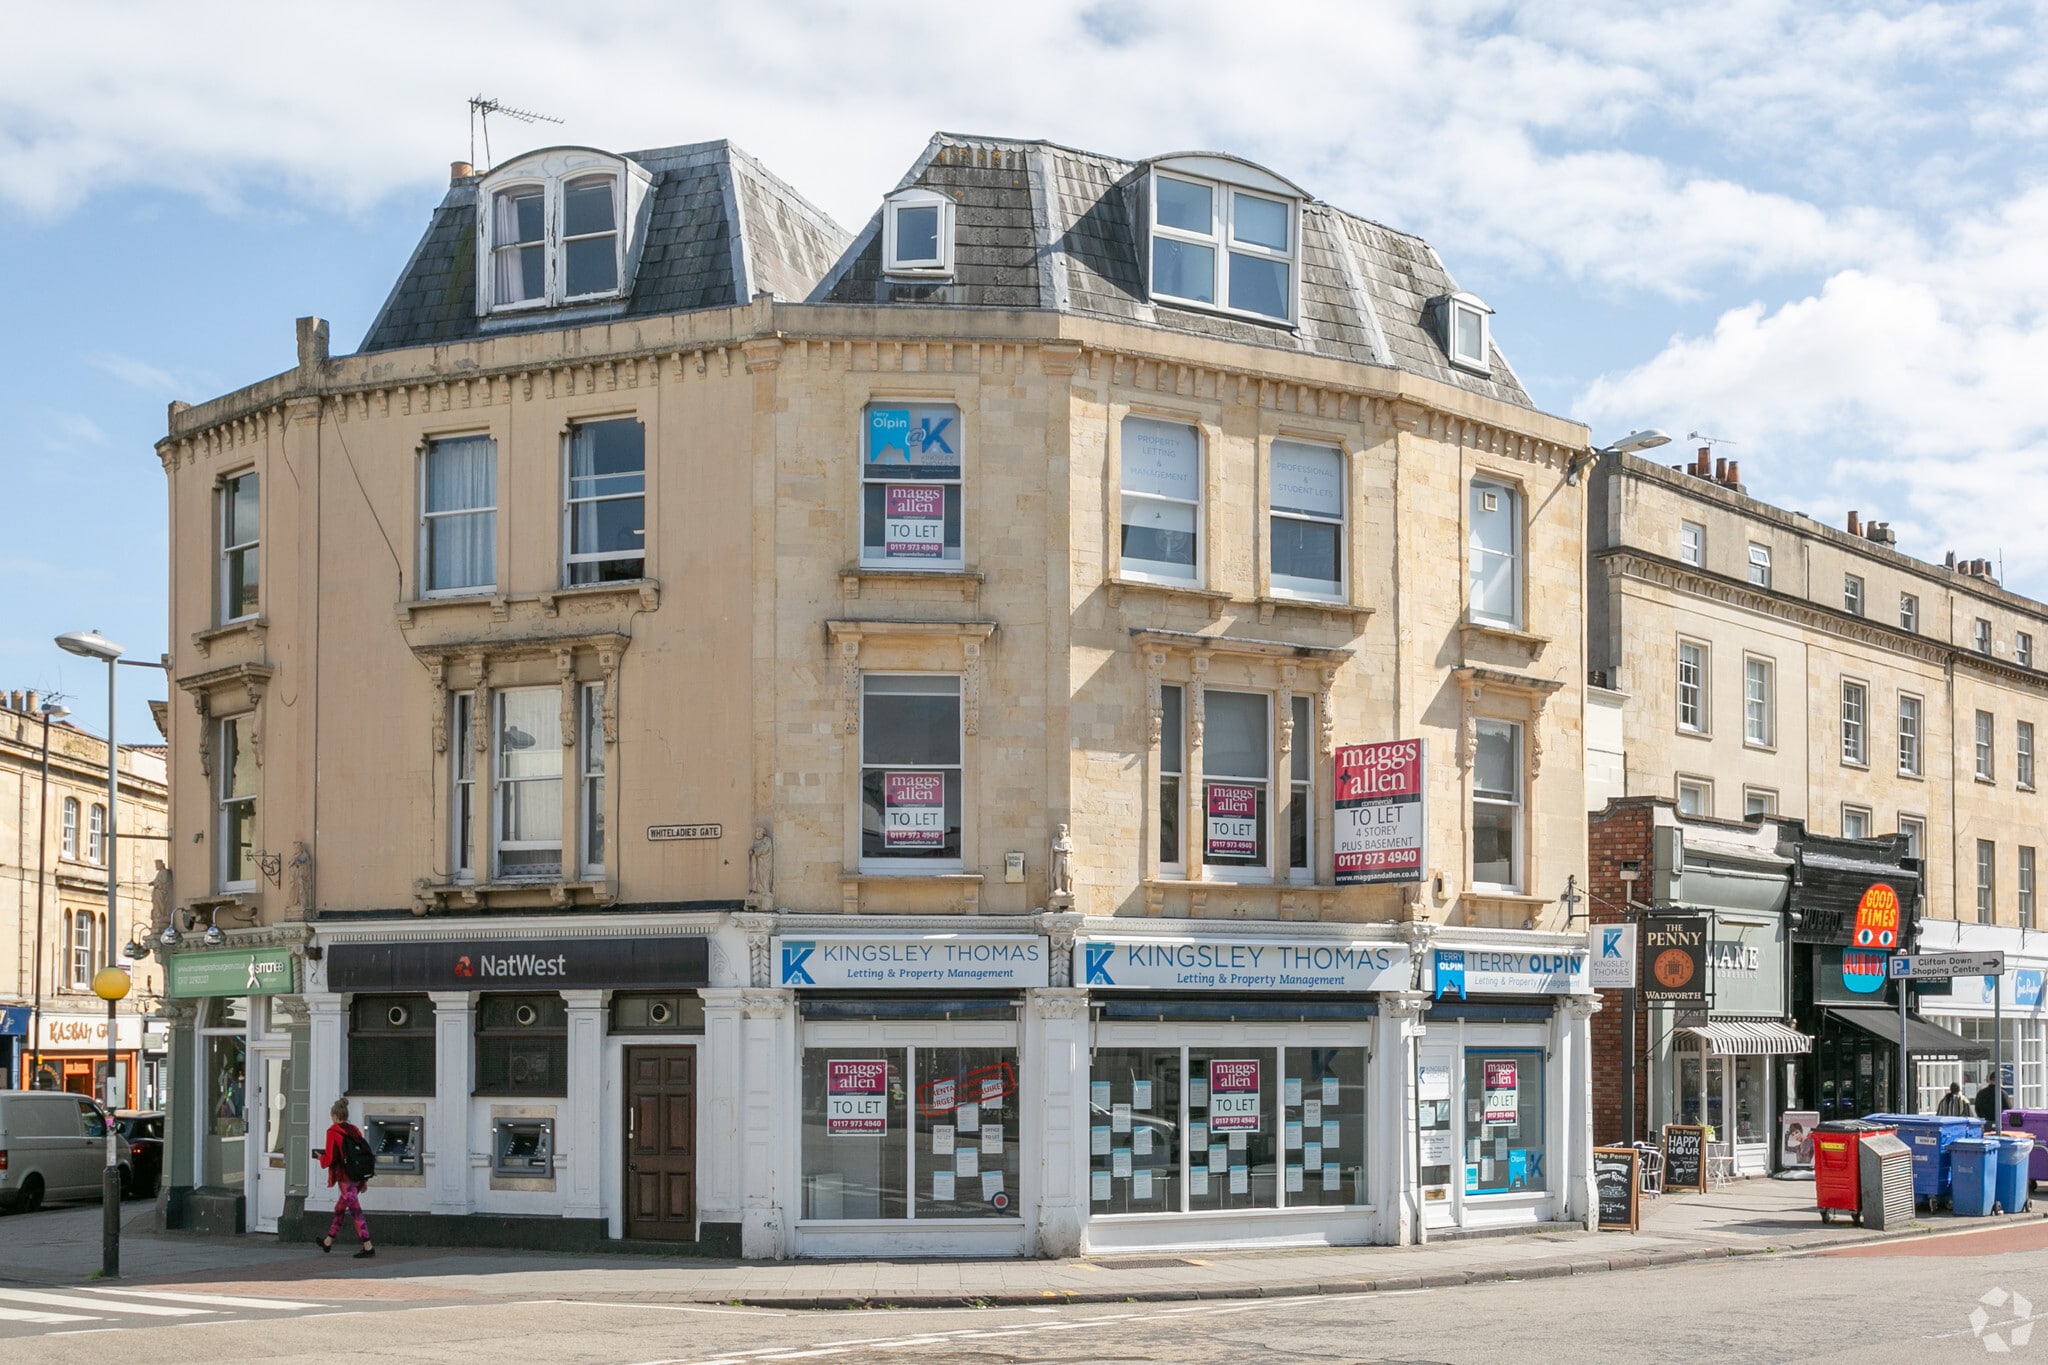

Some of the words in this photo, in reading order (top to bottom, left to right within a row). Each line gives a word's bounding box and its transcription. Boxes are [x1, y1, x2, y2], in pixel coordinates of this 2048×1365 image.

[873, 417, 907, 429] Olpin
[1138, 434, 1180, 446] PROPERTY
[1142, 446, 1176, 458] LETTING
[1130, 467, 1187, 481] MANAGEMENT
[1276, 462, 1335, 478] PROFESSIONAL
[892, 488, 940, 502] maggs
[1279, 483, 1312, 495] STUDENT
[1314, 488, 1334, 498] LETS
[898, 499, 934, 512] allen
[890, 524, 910, 538] TO
[915, 525, 938, 538] LET
[1342, 742, 1417, 771] maggs
[892, 776, 940, 790] maggs
[1350, 767, 1406, 794] allen
[897, 787, 934, 800] allen
[1214, 788, 1253, 802] maggs
[1218, 798, 1248, 812] allen
[890, 812, 910, 826] TO
[916, 813, 938, 826] LET
[1350, 808, 1372, 826] TO
[1378, 806, 1404, 824] LET
[650, 828, 697, 838] WHITELADIES
[700, 827, 719, 836] GATE
[1213, 822, 1229, 835] TO
[1232, 824, 1252, 836] LET
[1356, 828, 1362, 837] 4
[1364, 826, 1398, 837] STOREY
[1342, 841, 1362, 851] PLUS
[1365, 836, 1414, 850] BASEMENT
[1338, 854, 1363, 867] 0117
[1364, 852, 1385, 865] 973
[1388, 850, 1416, 863] 4940
[1336, 870, 1420, 882] www.maggsandallen.co.uk
[1866, 889, 1894, 909] GOOD
[1860, 908, 1896, 928] TIMES
[1665, 924, 1683, 932] THE
[1647, 932, 1702, 946] PENNY
[824, 945, 933, 962] KINGSLEY
[944, 945, 1040, 961] THOMAS
[1128, 944, 1264, 968] KINGSLEY
[1278, 947, 1390, 970] THOMAS
[1439, 951, 1464, 962] TERRY
[480, 954, 566, 976] NatWest
[1439, 962, 1464, 971] OLPIN
[1469, 952, 1524, 972] TERRY
[1529, 954, 1581, 974] OLPIN
[1594, 960, 1630, 968] KINGSLEY
[1844, 952, 1884, 976] HUBBOX
[1918, 958, 1946, 966] Clifton
[1950, 957, 1972, 965] Down
[847, 968, 884, 980] Letting
[887, 970, 896, 978] &
[900, 969, 944, 980] Property
[947, 969, 1014, 980] Management
[1594, 968, 1630, 976] THOMAS
[1912, 967, 1949, 976] Shopping
[1176, 973, 1215, 986] Letting
[1218, 974, 1227, 984] &
[1230, 974, 1276, 986] Property
[1279, 974, 1345, 987] Management
[1474, 976, 1498, 988] Letting
[1500, 976, 1506, 985] &
[1508, 976, 1538, 989] Property
[1645, 991, 1702, 999] WADWORTH
[834, 1064, 882, 1078] maggs
[1216, 1064, 1256, 1076] maggs
[1488, 1063, 1515, 1076] maggs
[840, 1075, 876, 1088] allen
[1221, 1074, 1251, 1087] allen
[1490, 1072, 1512, 1084] allen
[1216, 1098, 1232, 1111] TO
[1236, 1098, 1255, 1111] LET
[1488, 1095, 1499, 1106] TO
[1501, 1095, 1514, 1106] LET
[833, 1101, 852, 1114] TO
[858, 1101, 881, 1114] LET
[1668, 1135, 1700, 1147] HAPPY
[1668, 1147, 1700, 1155] HOUR
[1511, 1155, 1525, 1163] Olpin
